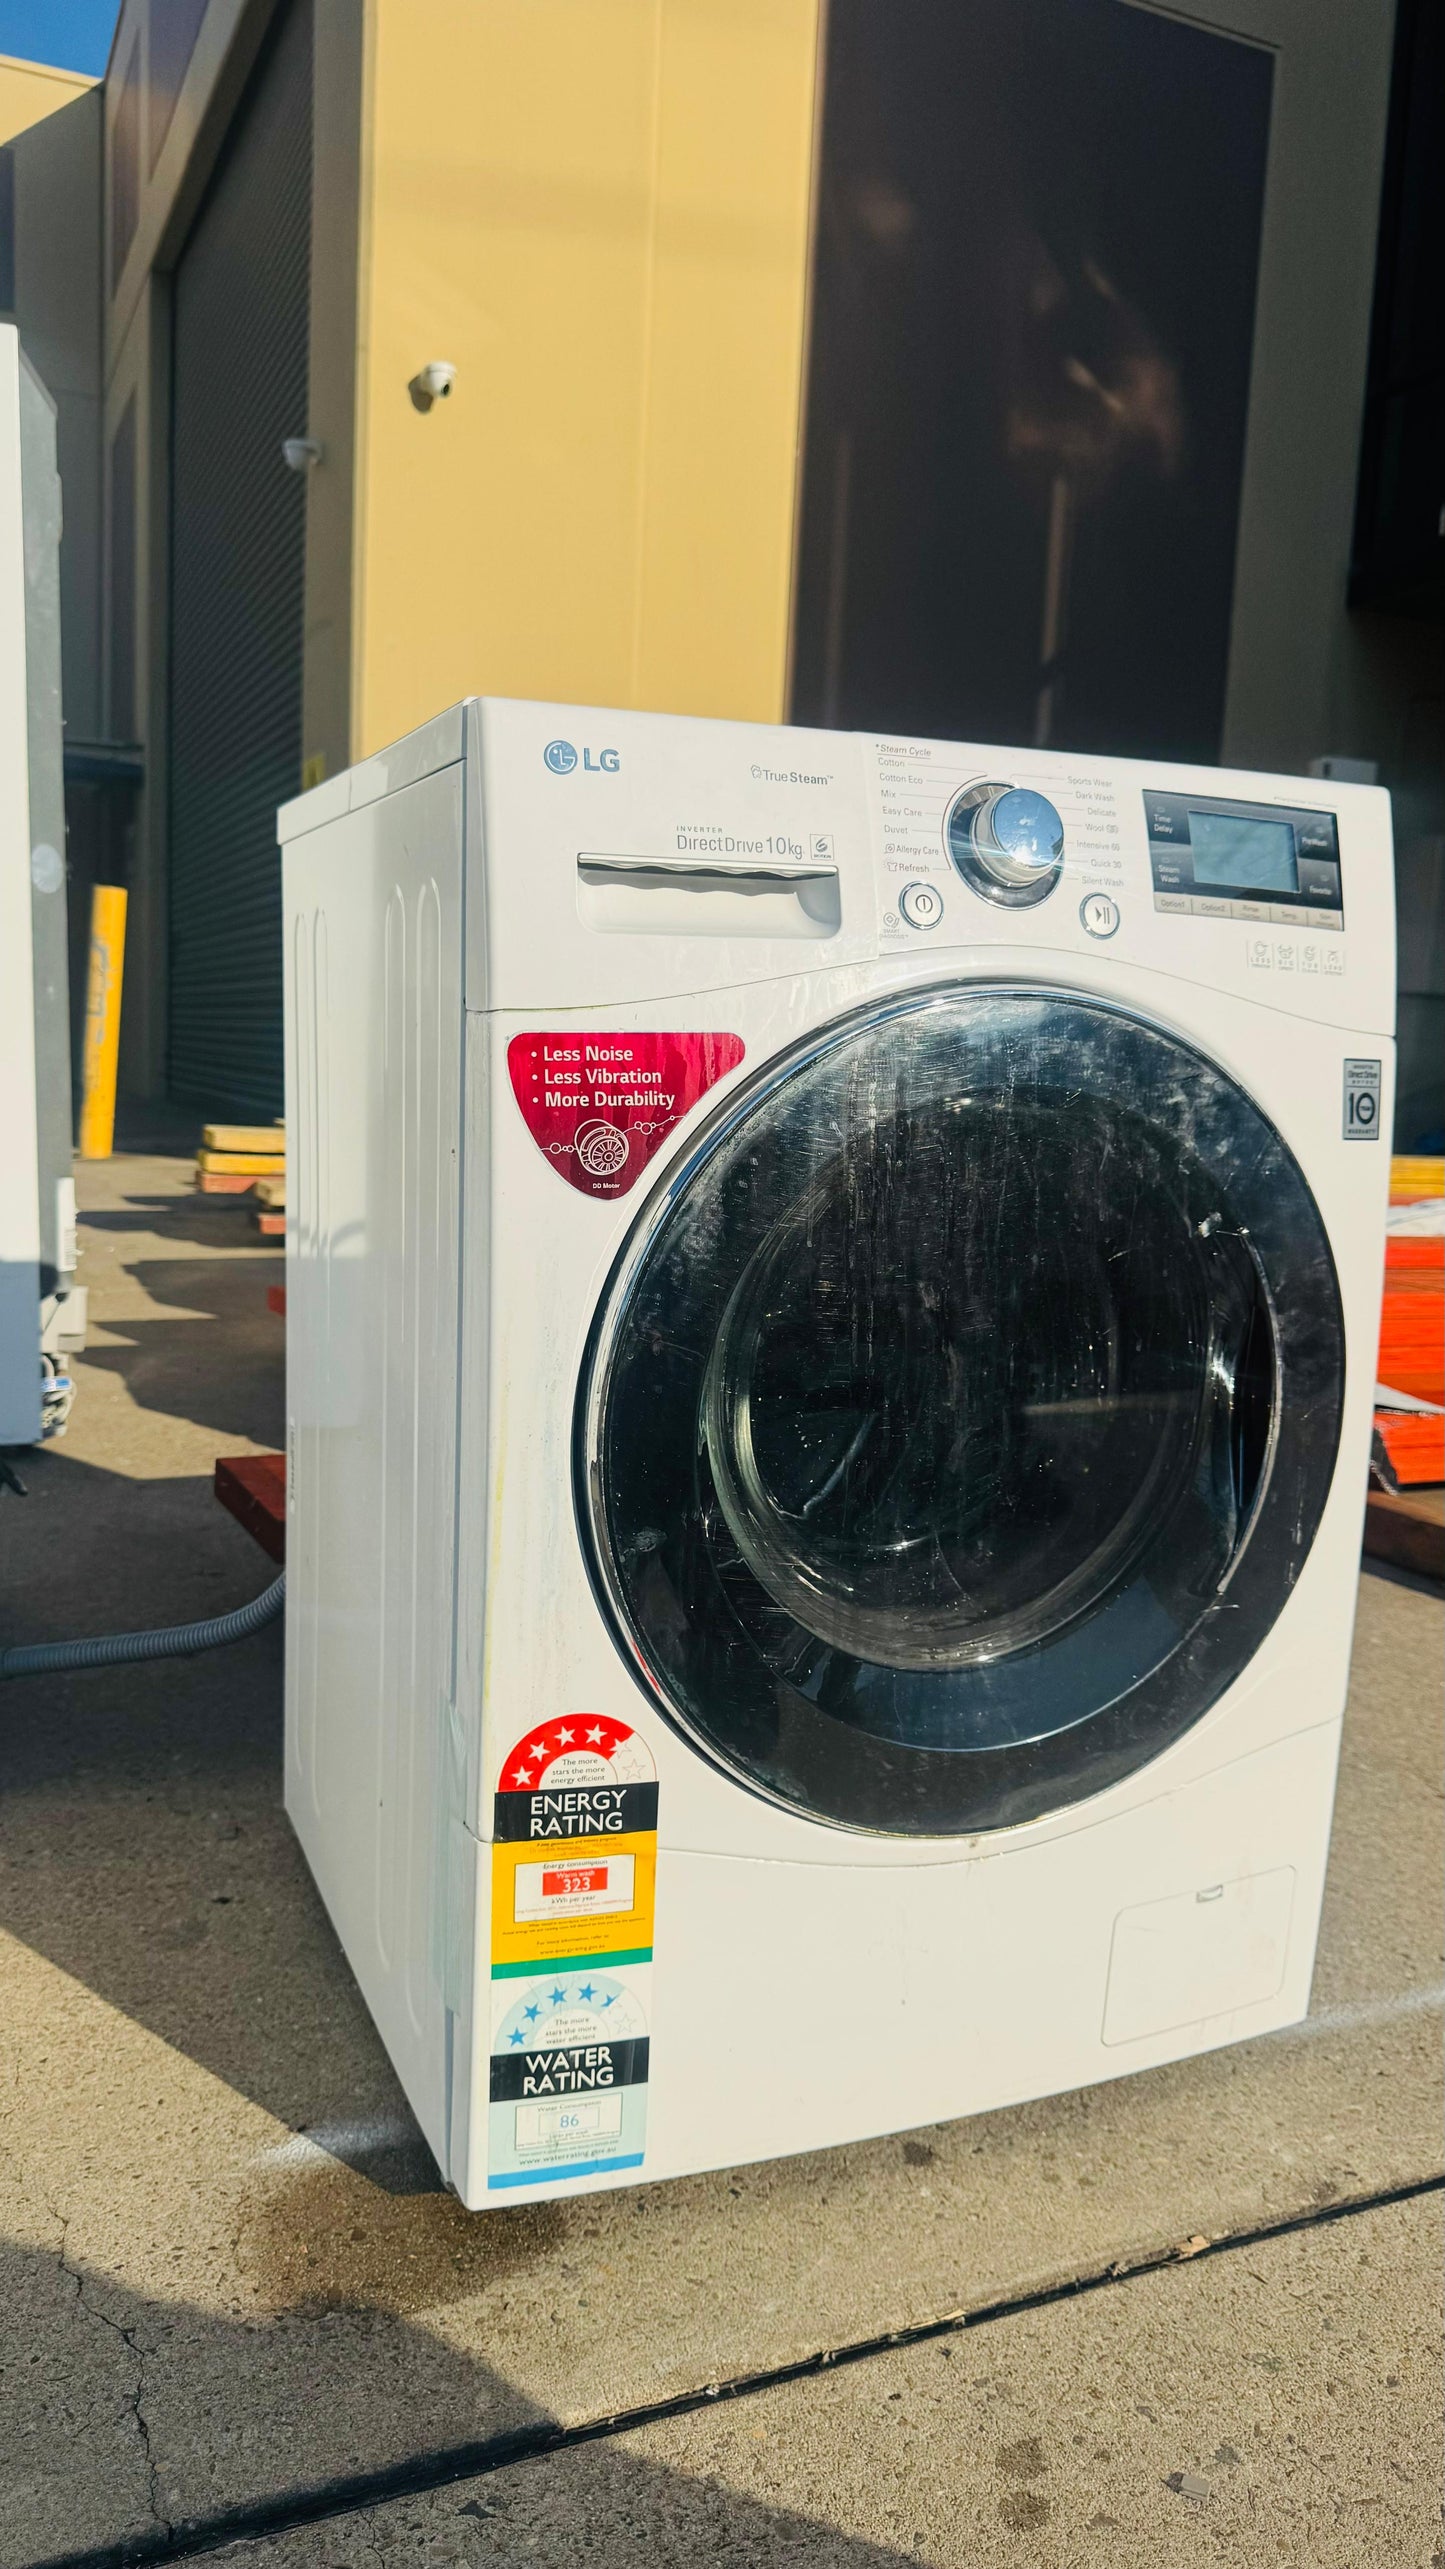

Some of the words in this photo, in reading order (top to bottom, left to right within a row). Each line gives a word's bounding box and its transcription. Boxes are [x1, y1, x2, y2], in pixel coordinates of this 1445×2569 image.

[908, 747, 932, 757] Cycle
[584, 748, 620, 772] LG
[878, 758, 905, 768] Cotton
[880, 773, 906, 783] Cotton
[908, 775, 924, 784] Eco
[1067, 776, 1092, 786] Sports
[880, 790, 896, 798] Mix
[1076, 792, 1093, 800] Dark
[1094, 793, 1114, 802] Wash
[882, 806, 902, 816] Easy
[904, 808, 922, 816] Care
[1087, 808, 1117, 817] Delicate
[1154, 814, 1172, 822] Time
[676, 826, 723, 834] INVERTER
[884, 824, 908, 834] Duvet
[1085, 824, 1104, 832] Wool
[1154, 824, 1174, 834] Delay
[1076, 840, 1110, 850] Intensive
[896, 845, 922, 856] Allergy
[923, 846, 939, 855] Care
[898, 863, 930, 872] Refresh
[1090, 858, 1112, 868] Quick
[1112, 860, 1122, 869] 30
[1158, 864, 1180, 874] Steam
[1082, 876, 1102, 886] Silent
[1104, 878, 1124, 887] Wash
[1160, 874, 1180, 884] Wash
[544, 1046, 580, 1061] Less
[586, 1046, 634, 1061] Noise
[544, 1068, 581, 1084] Less
[586, 1068, 662, 1084] Vibration
[545, 1092, 590, 1107] More
[594, 1090, 675, 1110] Durability
[1348, 1092, 1376, 1124] 10
[562, 1758, 576, 1766] The
[552, 1768, 570, 1776] stars
[577, 1774, 605, 1782] efficient
[530, 1790, 627, 1815] ENERGY
[530, 1812, 622, 1838] RATING
[543, 1862, 565, 1870] Energy
[566, 1859, 608, 1868] consumption
[556, 1871, 578, 1879] Warm
[562, 1876, 591, 1894] 323
[569, 1896, 580, 1904] per
[582, 1895, 596, 1903] year
[556, 2018, 568, 2026] The
[564, 2026, 576, 2034] the
[578, 2025, 597, 2033] more
[526, 2046, 612, 2074] WATER
[523, 2066, 614, 2096] RATING
[560, 2114, 580, 2128] 86
